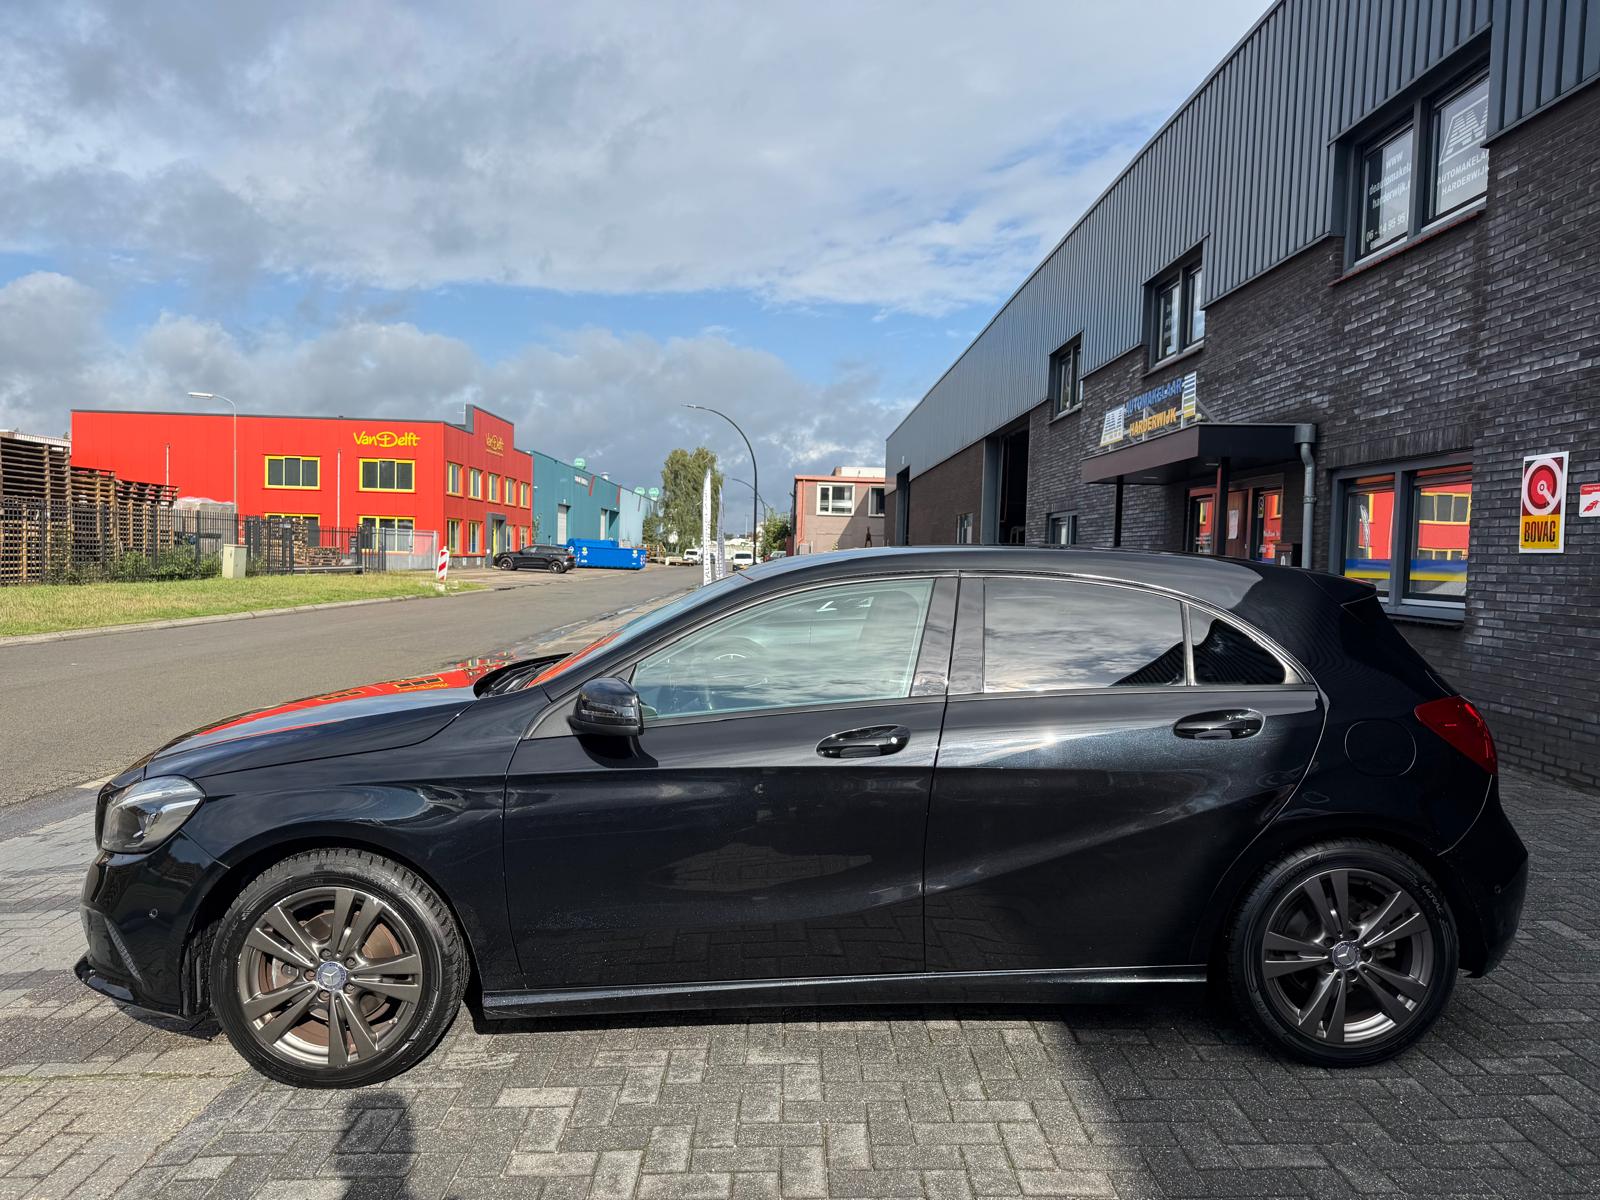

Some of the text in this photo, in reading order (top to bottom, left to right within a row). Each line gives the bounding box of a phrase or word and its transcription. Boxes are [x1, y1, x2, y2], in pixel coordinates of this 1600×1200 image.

[1126, 378, 1183, 416] AUTOMAKELAAR
[1129, 407, 1177, 437] HARDERWIJK
[1524, 520, 1556, 543] BOVAG
